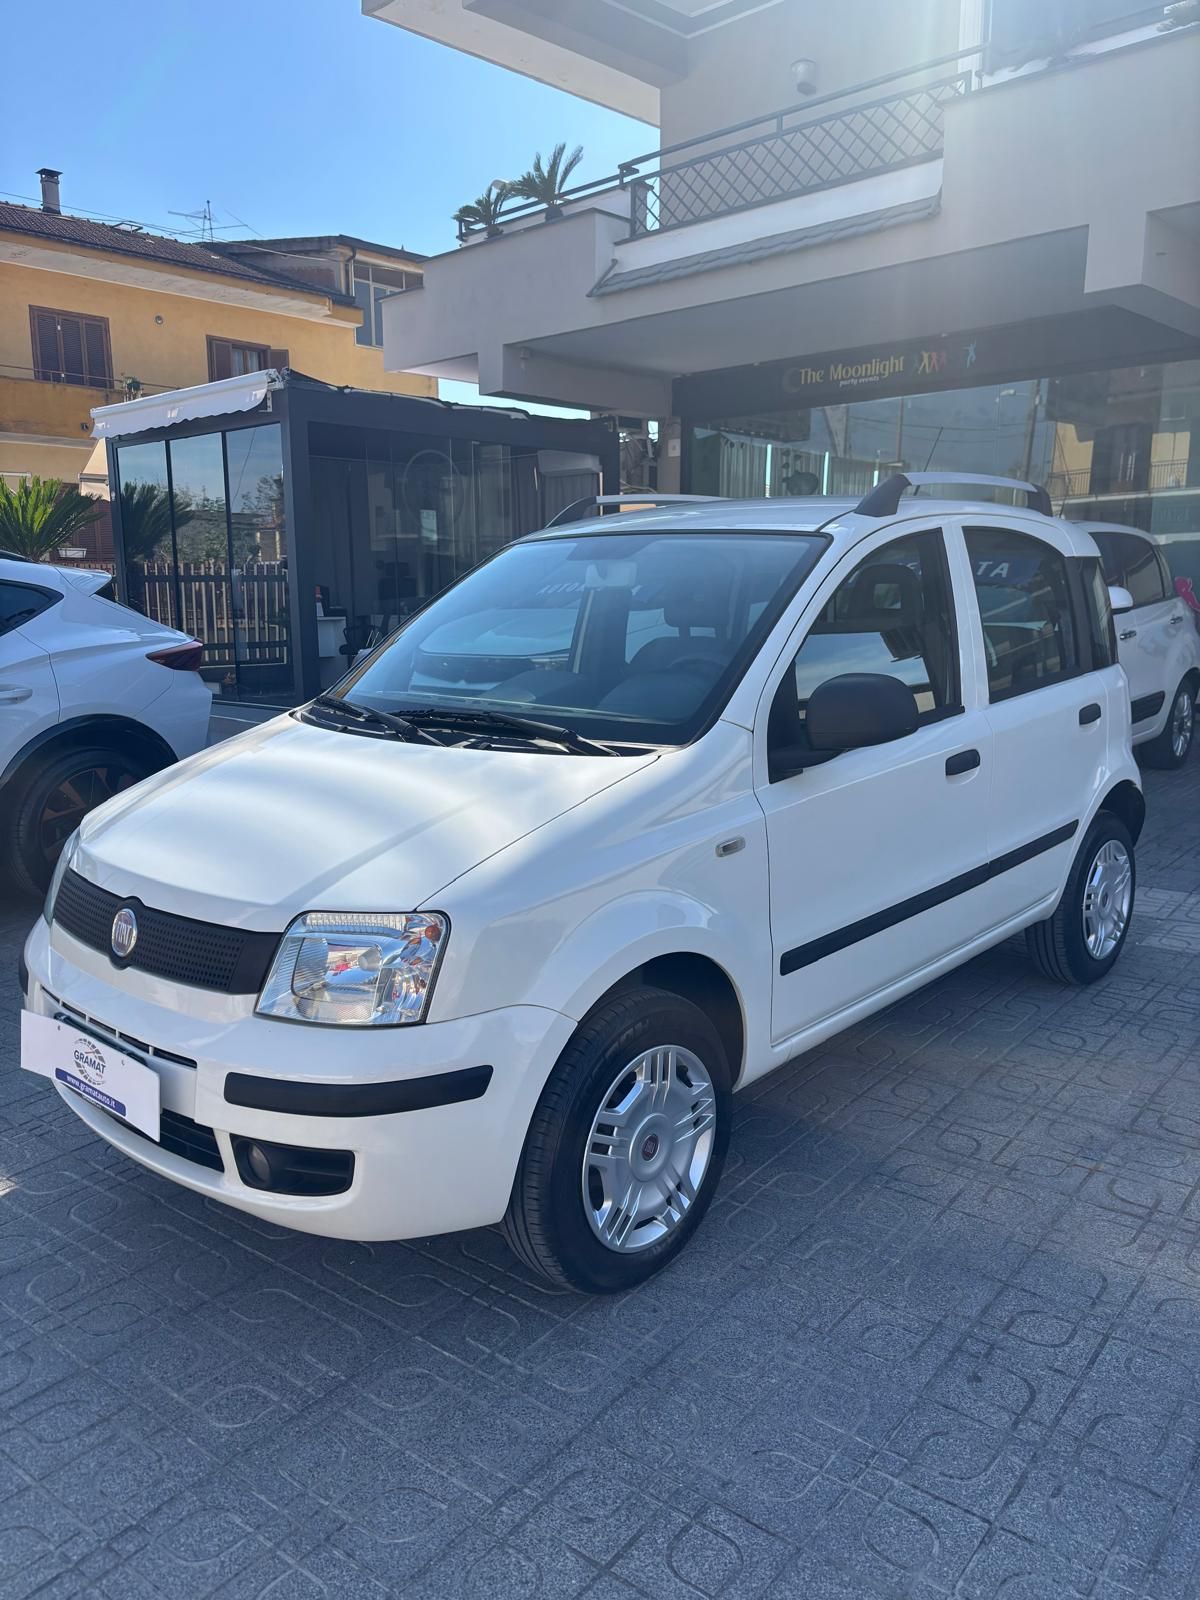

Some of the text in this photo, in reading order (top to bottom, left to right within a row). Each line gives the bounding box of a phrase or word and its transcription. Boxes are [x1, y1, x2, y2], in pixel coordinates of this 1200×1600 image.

[799, 355, 905, 385] The Moonlight
[839, 375, 880, 387] party events
[73, 1049, 106, 1074] GRAMAT
